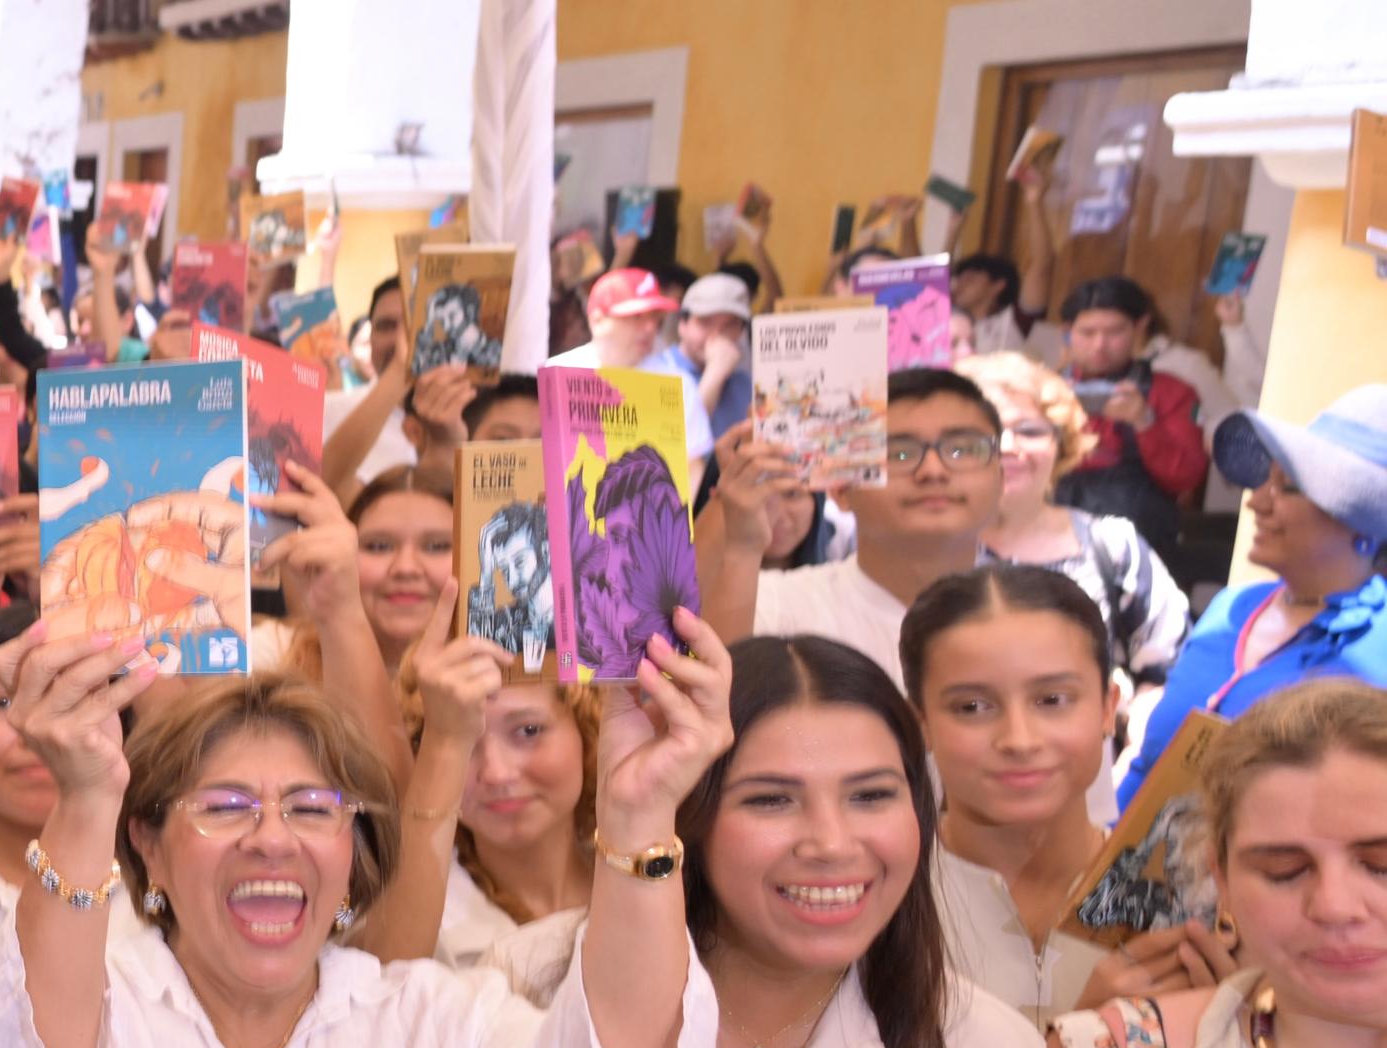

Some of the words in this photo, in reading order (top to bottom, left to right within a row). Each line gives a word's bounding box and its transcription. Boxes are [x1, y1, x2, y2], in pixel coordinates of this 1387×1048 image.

[785, 336, 828, 352] OLVIDO
[49, 379, 172, 410] HABLAPALABRA
[566, 375, 603, 398] VIENTO
[568, 400, 639, 428] PRIMAVERA
[473, 452, 485, 468] EL
[490, 452, 516, 469] VASO
[473, 469, 515, 489] LECHE
